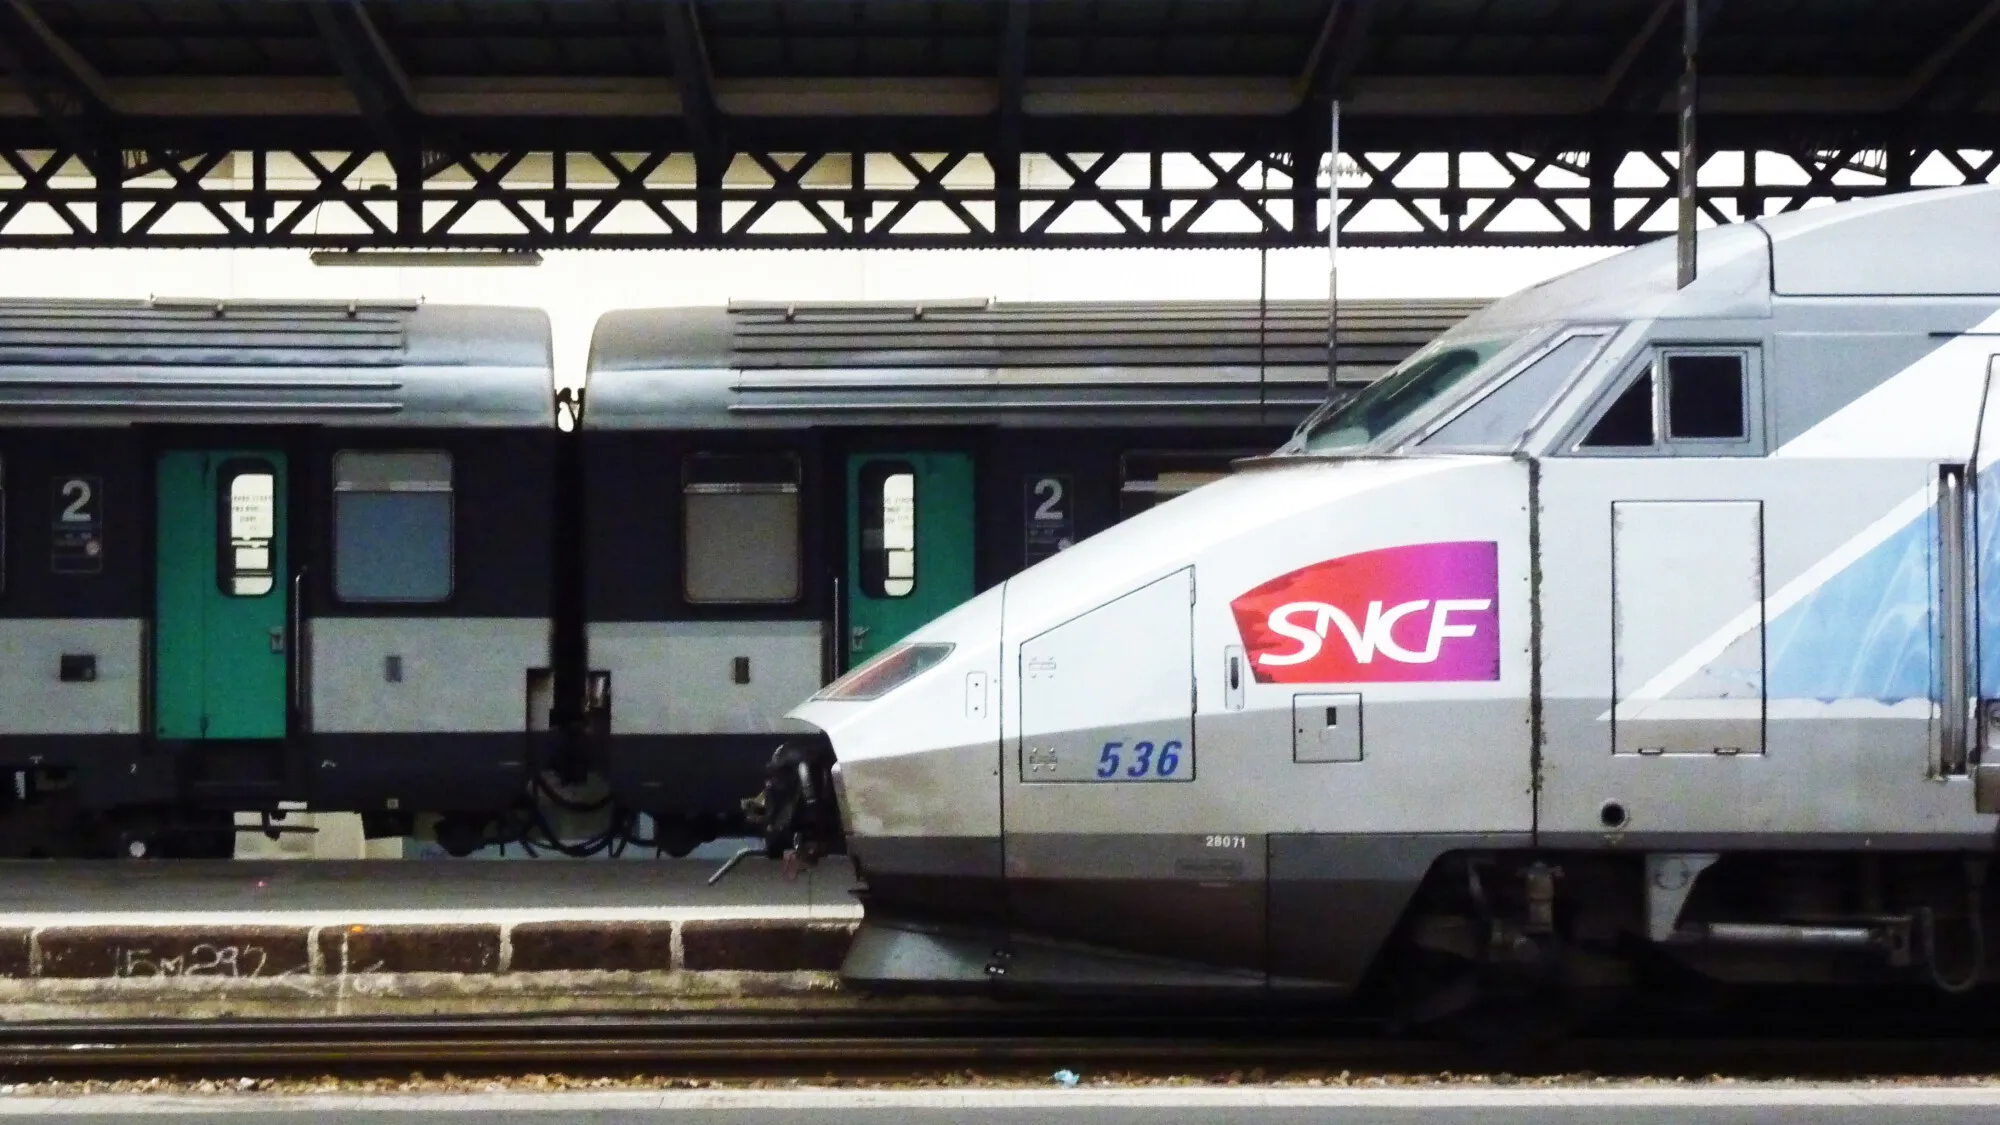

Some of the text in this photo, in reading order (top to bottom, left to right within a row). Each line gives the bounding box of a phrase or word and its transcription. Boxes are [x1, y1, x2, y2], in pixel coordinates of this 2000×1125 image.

[61, 479, 92, 522] 2
[1033, 478, 1064, 521] 2
[1257, 598, 1492, 666] SNCF
[1096, 740, 1183, 778] 536
[1205, 834, 1247, 849] 28071
